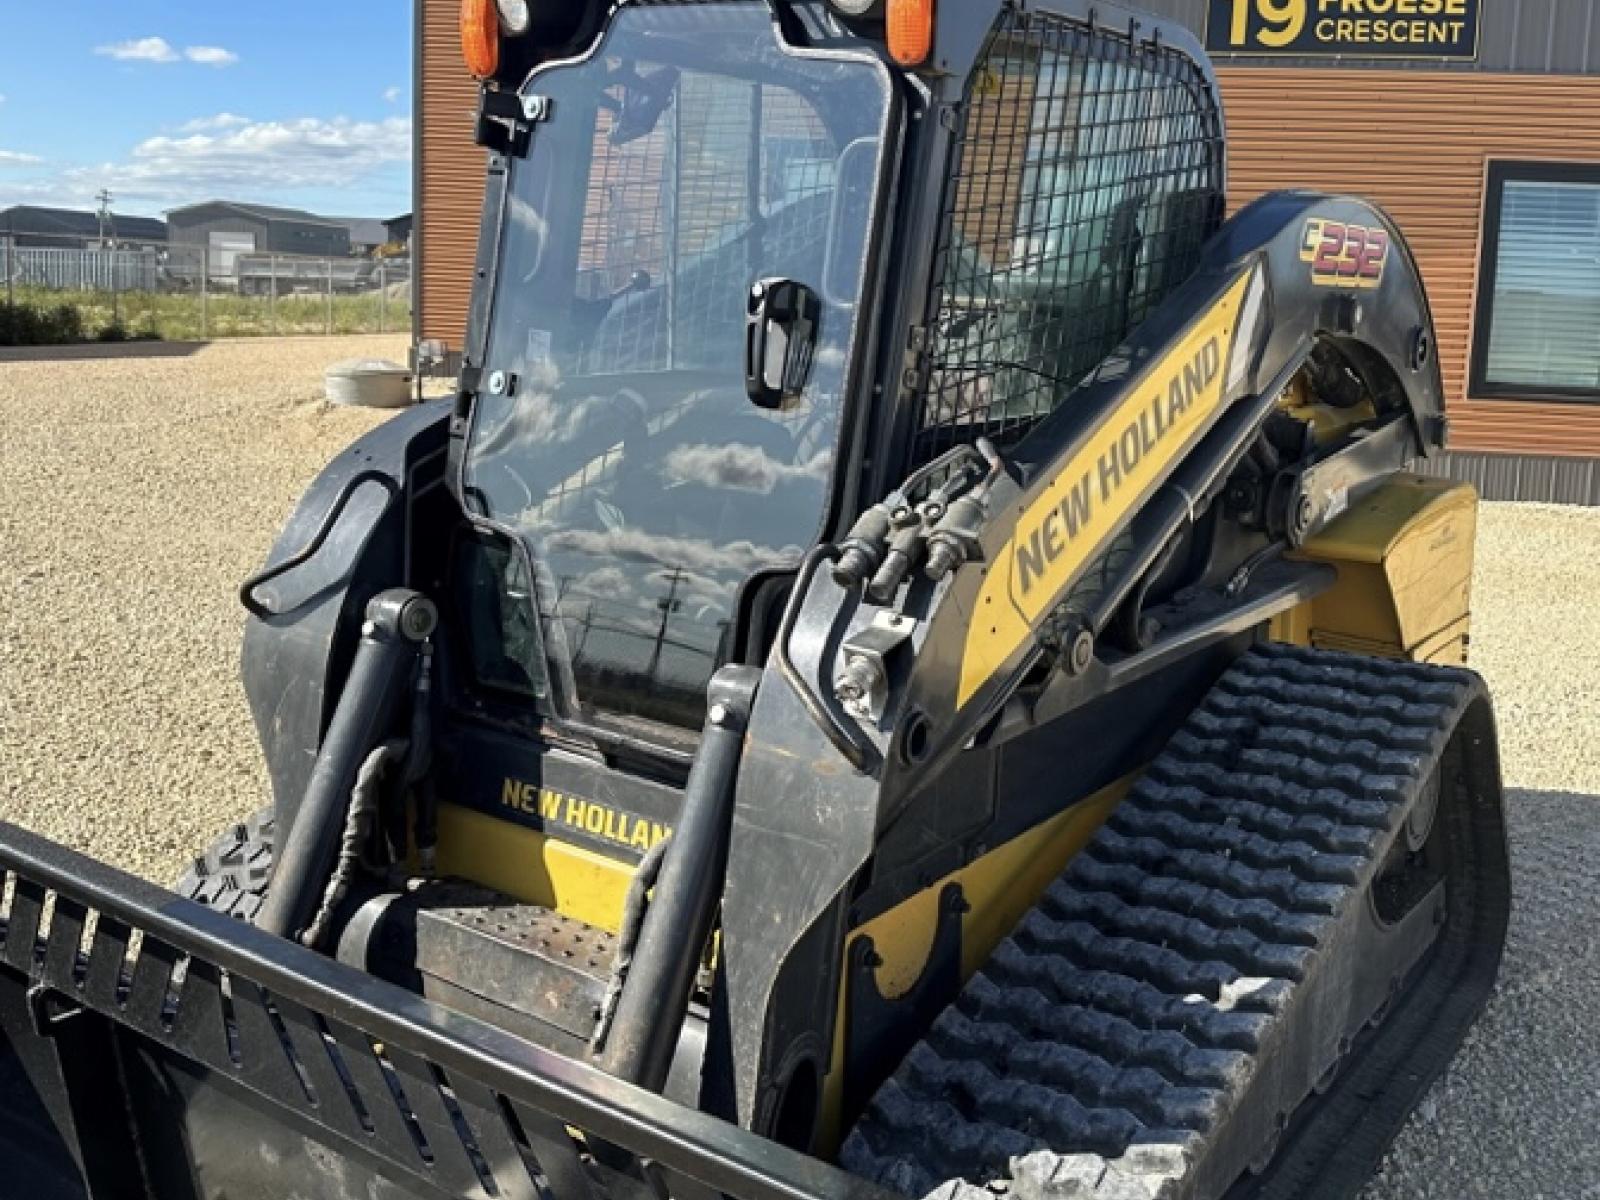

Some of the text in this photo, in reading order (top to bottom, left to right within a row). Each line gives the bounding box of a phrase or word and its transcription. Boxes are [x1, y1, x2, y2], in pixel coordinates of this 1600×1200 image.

[1229, 0, 1307, 47] 19
[1315, 18, 1465, 43] CRESCENT
[1015, 335, 1220, 594] NEW HOLLAND
[502, 777, 673, 850] NEW HOLLAN
